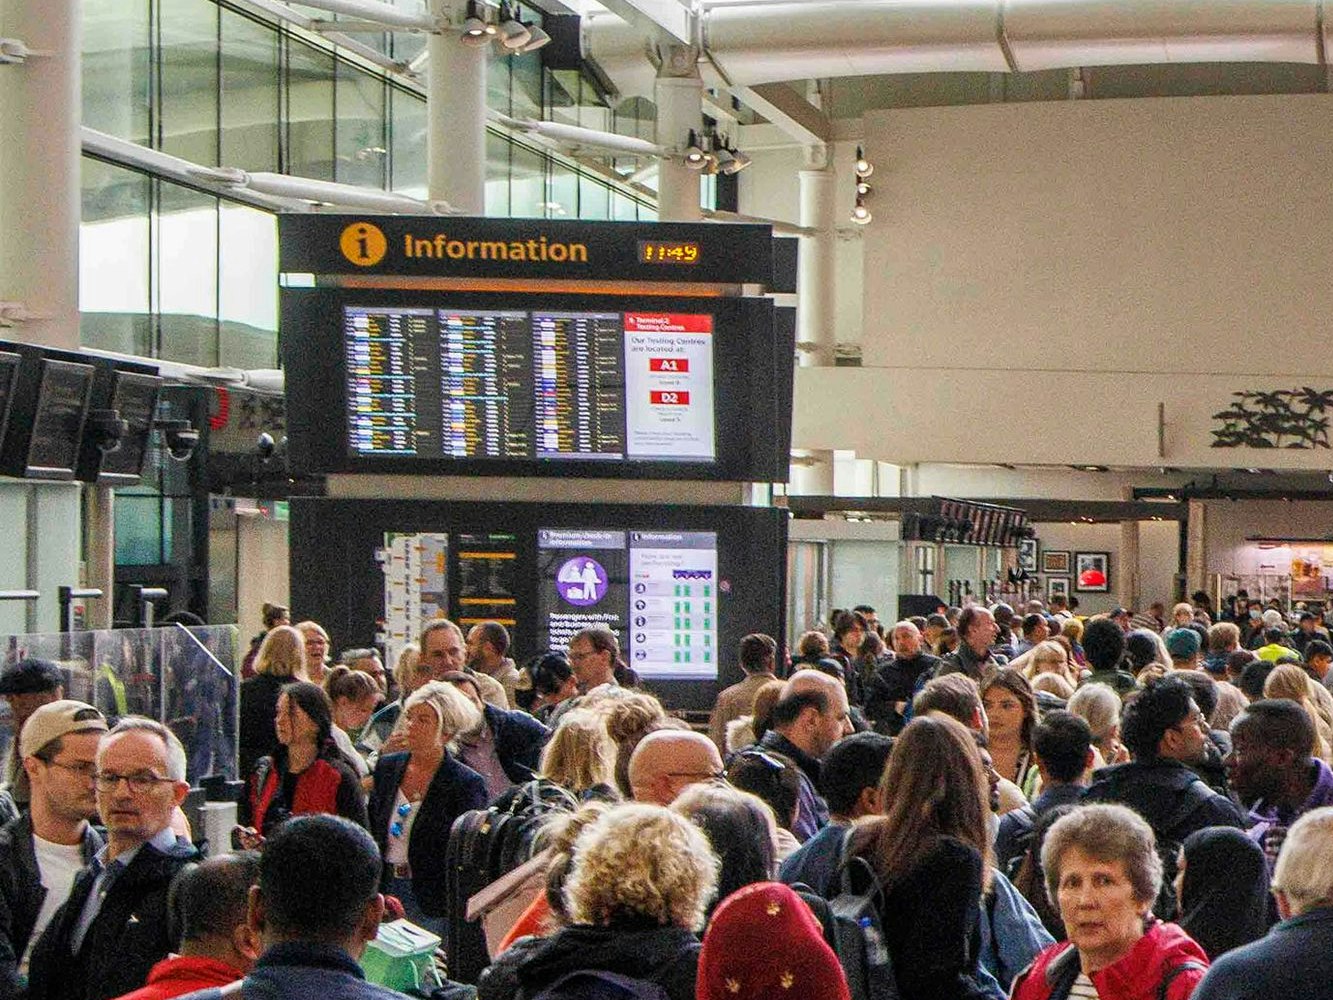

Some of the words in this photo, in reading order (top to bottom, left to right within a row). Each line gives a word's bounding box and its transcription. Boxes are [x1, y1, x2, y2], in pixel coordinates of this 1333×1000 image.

[404, 234, 588, 263] Information
[643, 246, 698, 262] 11:49
[661, 360, 677, 370] A1
[661, 393, 679, 403] D2
